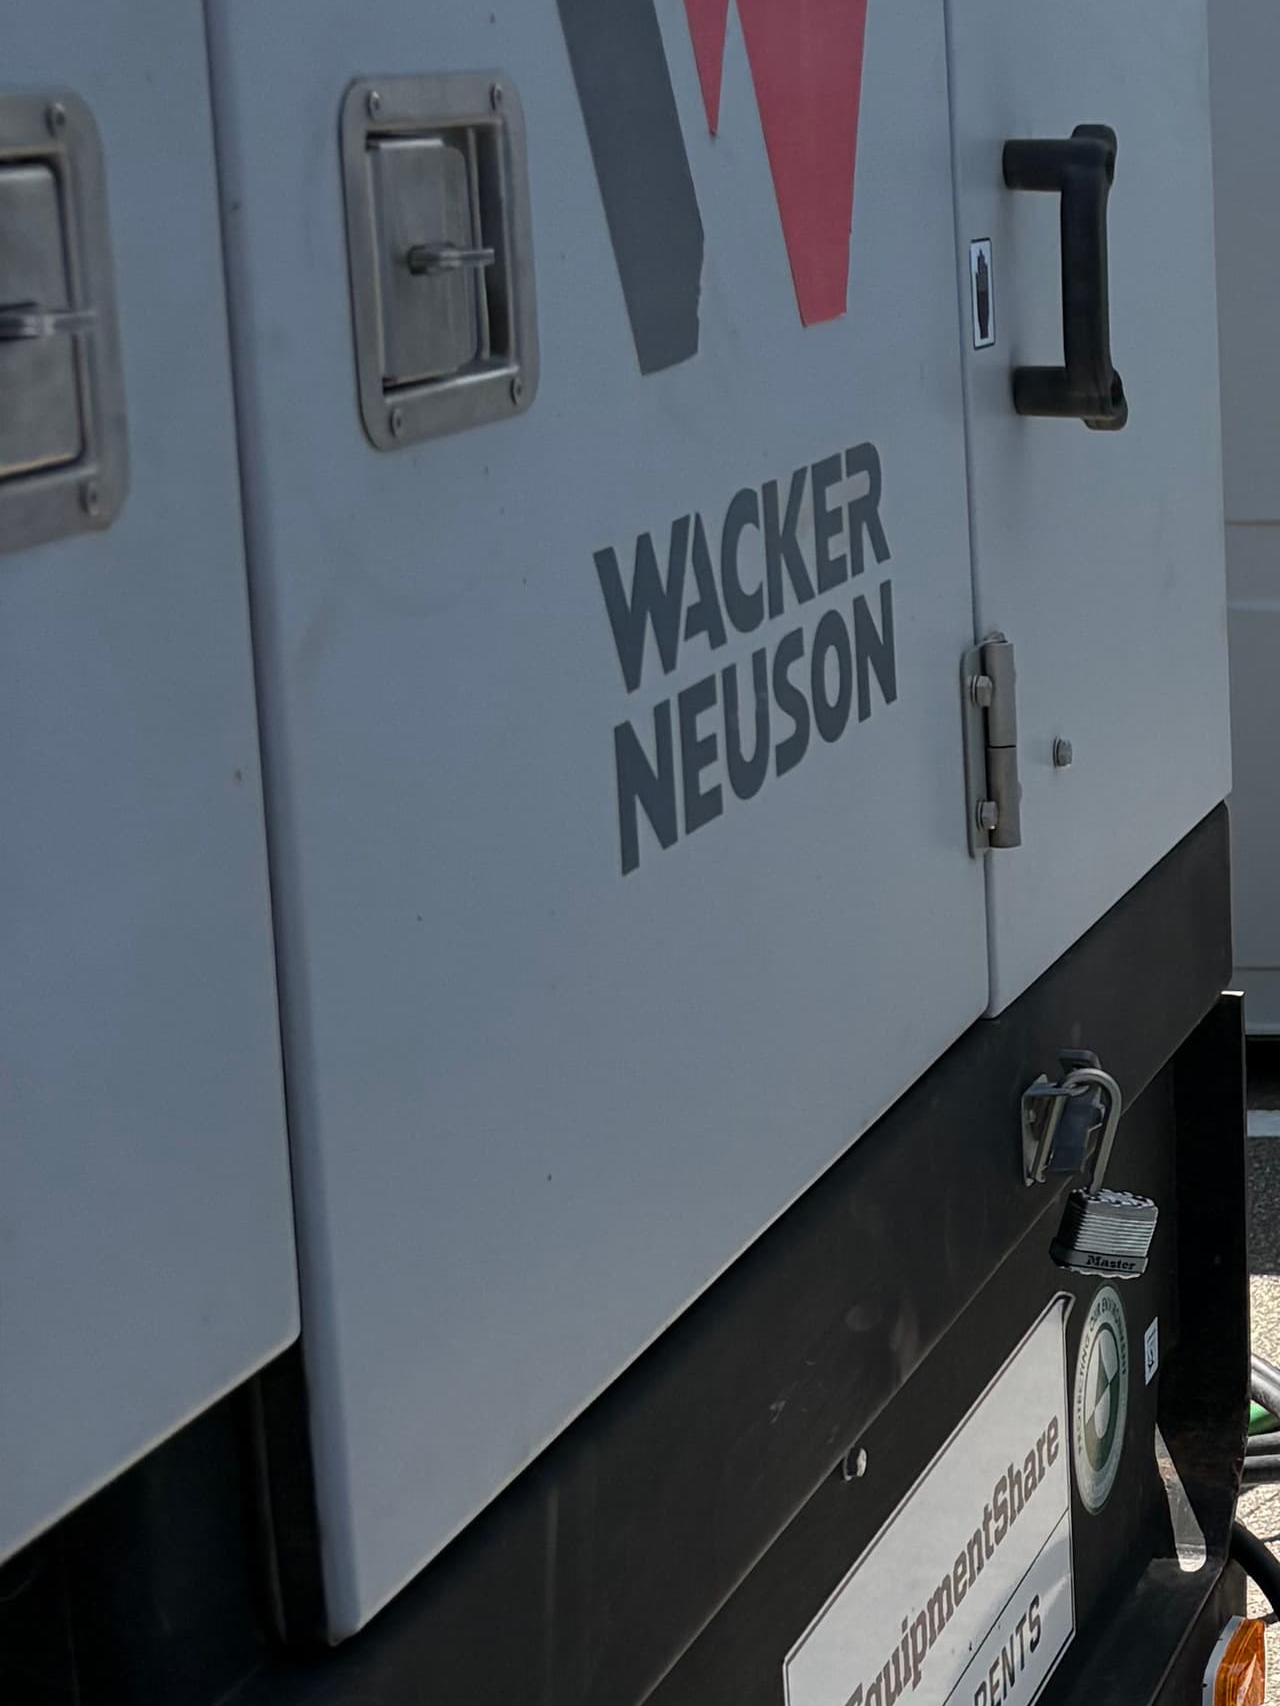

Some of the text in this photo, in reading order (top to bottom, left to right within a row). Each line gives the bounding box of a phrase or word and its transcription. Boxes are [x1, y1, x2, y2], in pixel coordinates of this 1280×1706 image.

[593, 441, 892, 694] WACKER
[613, 579, 898, 878] NEUSON
[1085, 1254, 1138, 1271] Master
